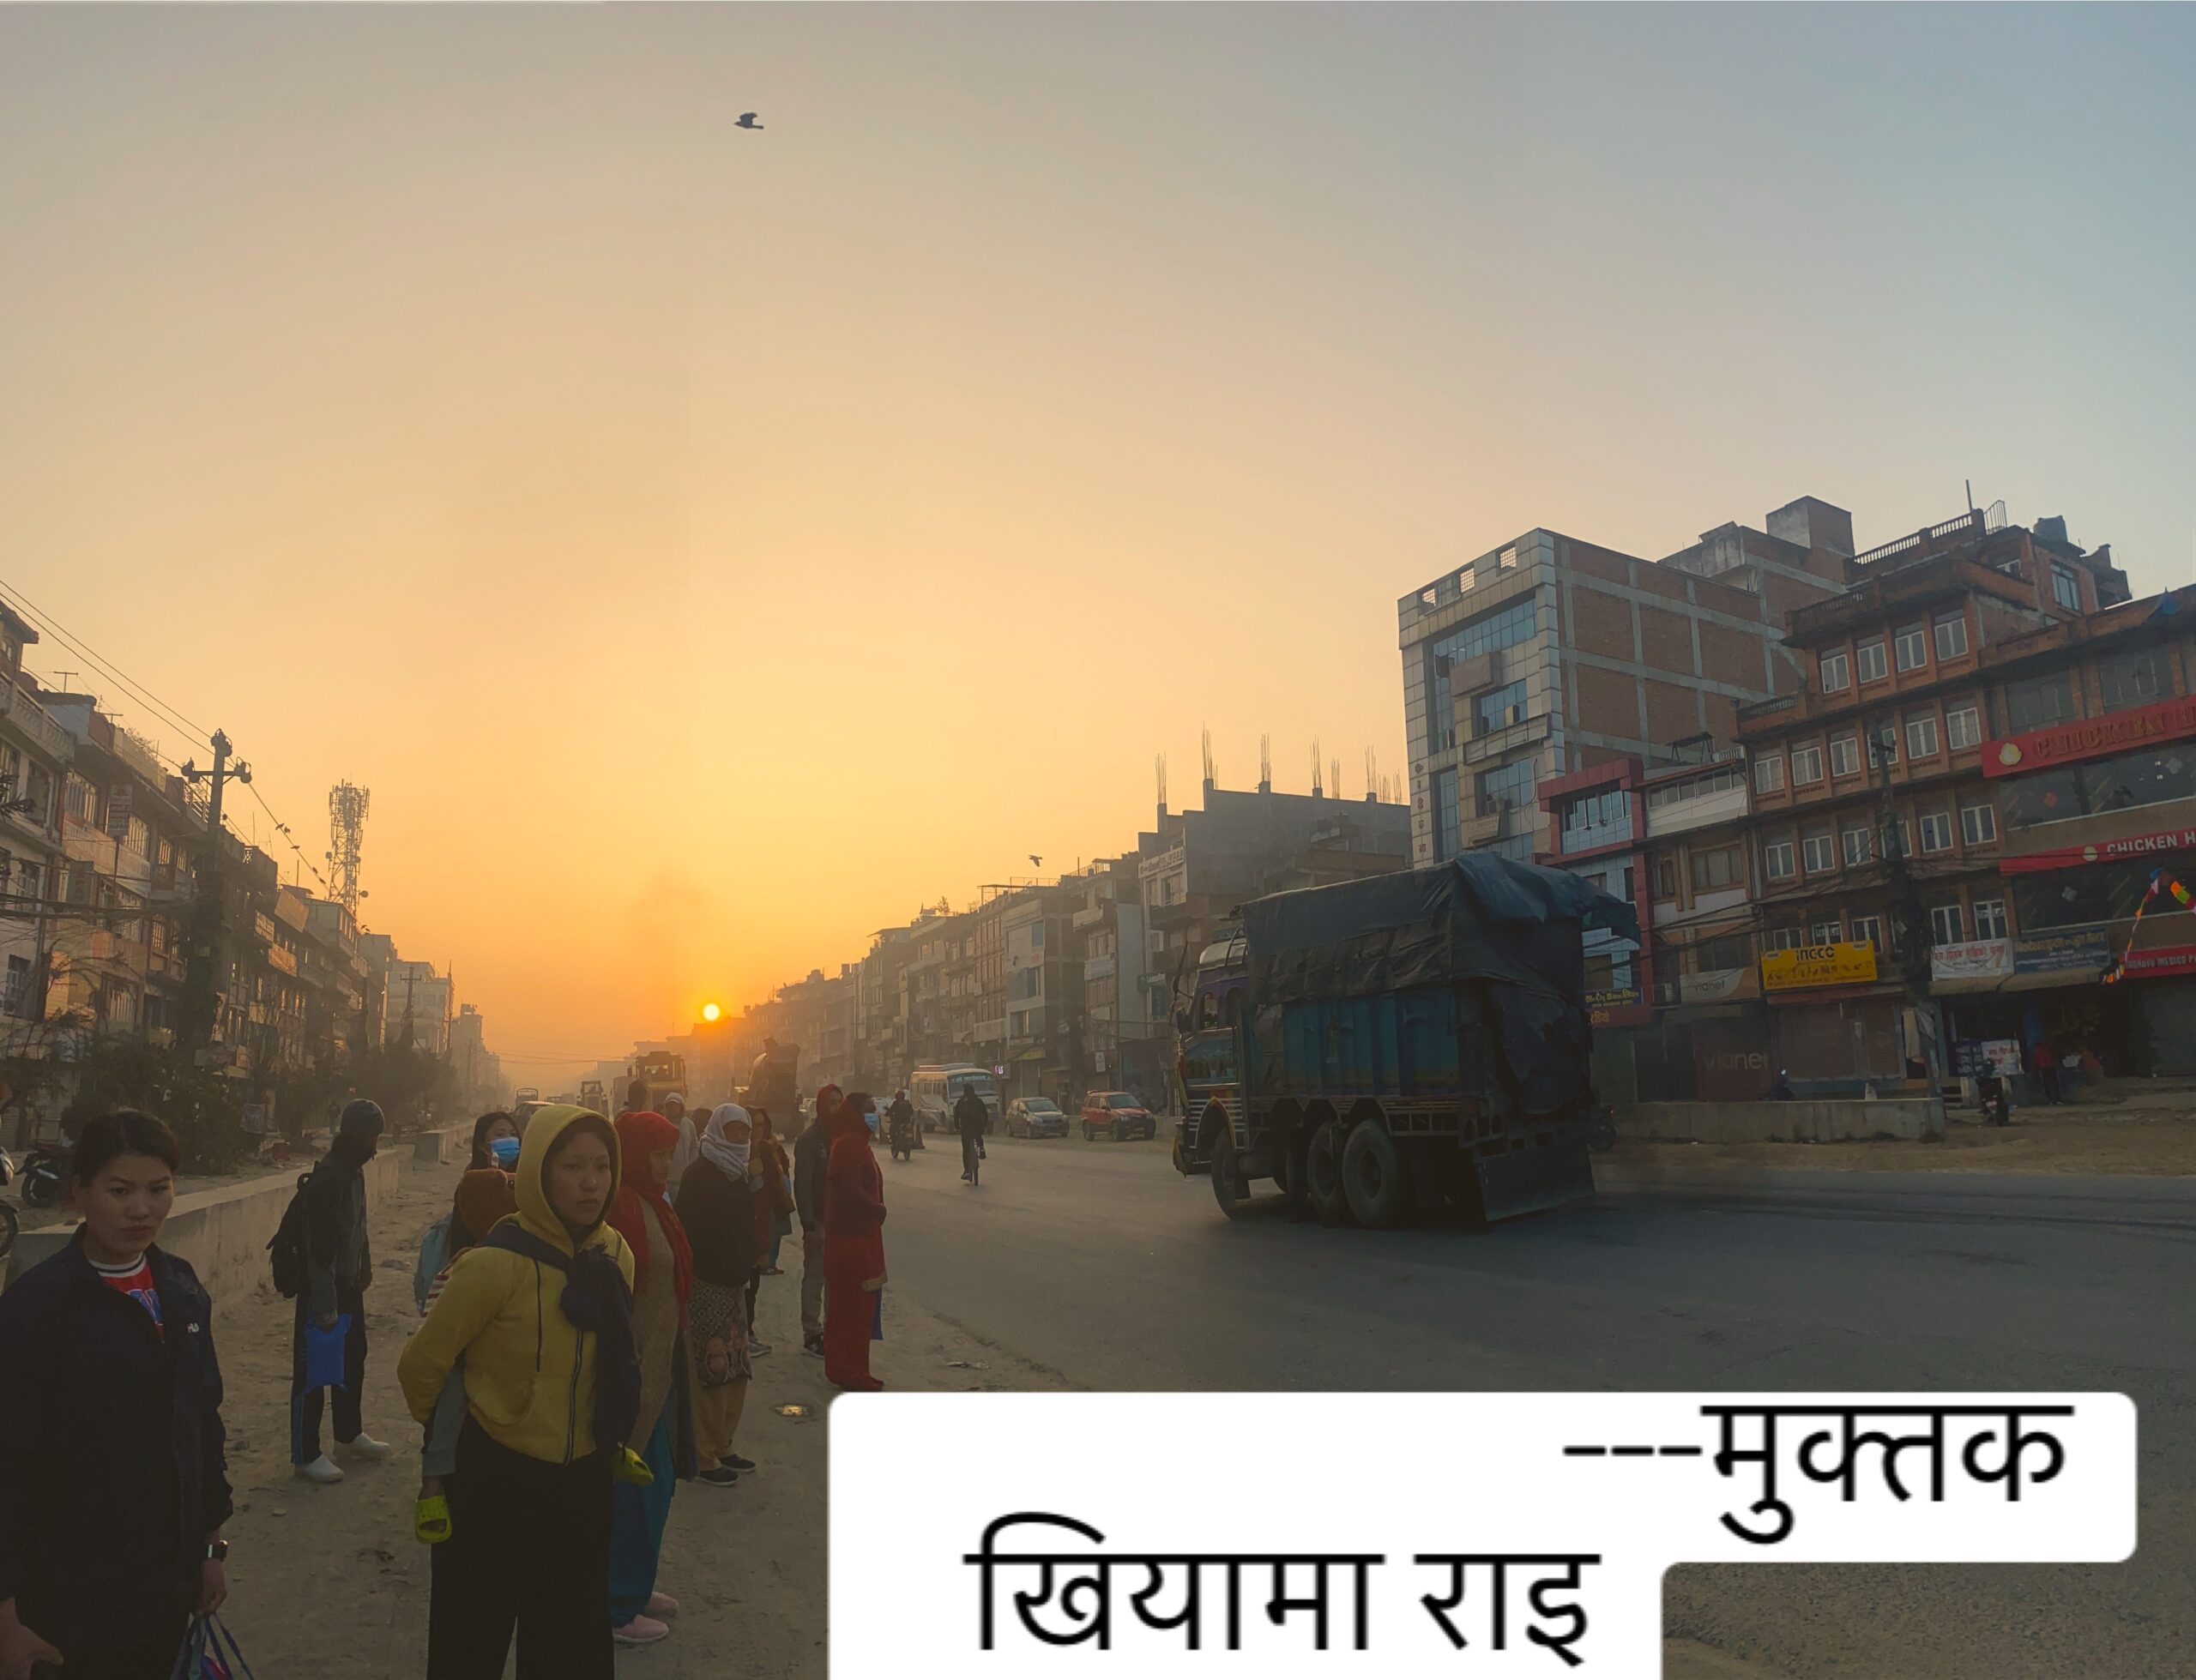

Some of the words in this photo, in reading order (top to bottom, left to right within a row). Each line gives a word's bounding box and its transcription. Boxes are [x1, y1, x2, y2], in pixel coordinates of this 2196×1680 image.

[2106, 832, 2178, 857] CHICKEN
[2157, 954, 2187, 967] MEDICO
[1694, 979, 1725, 991] vianet
